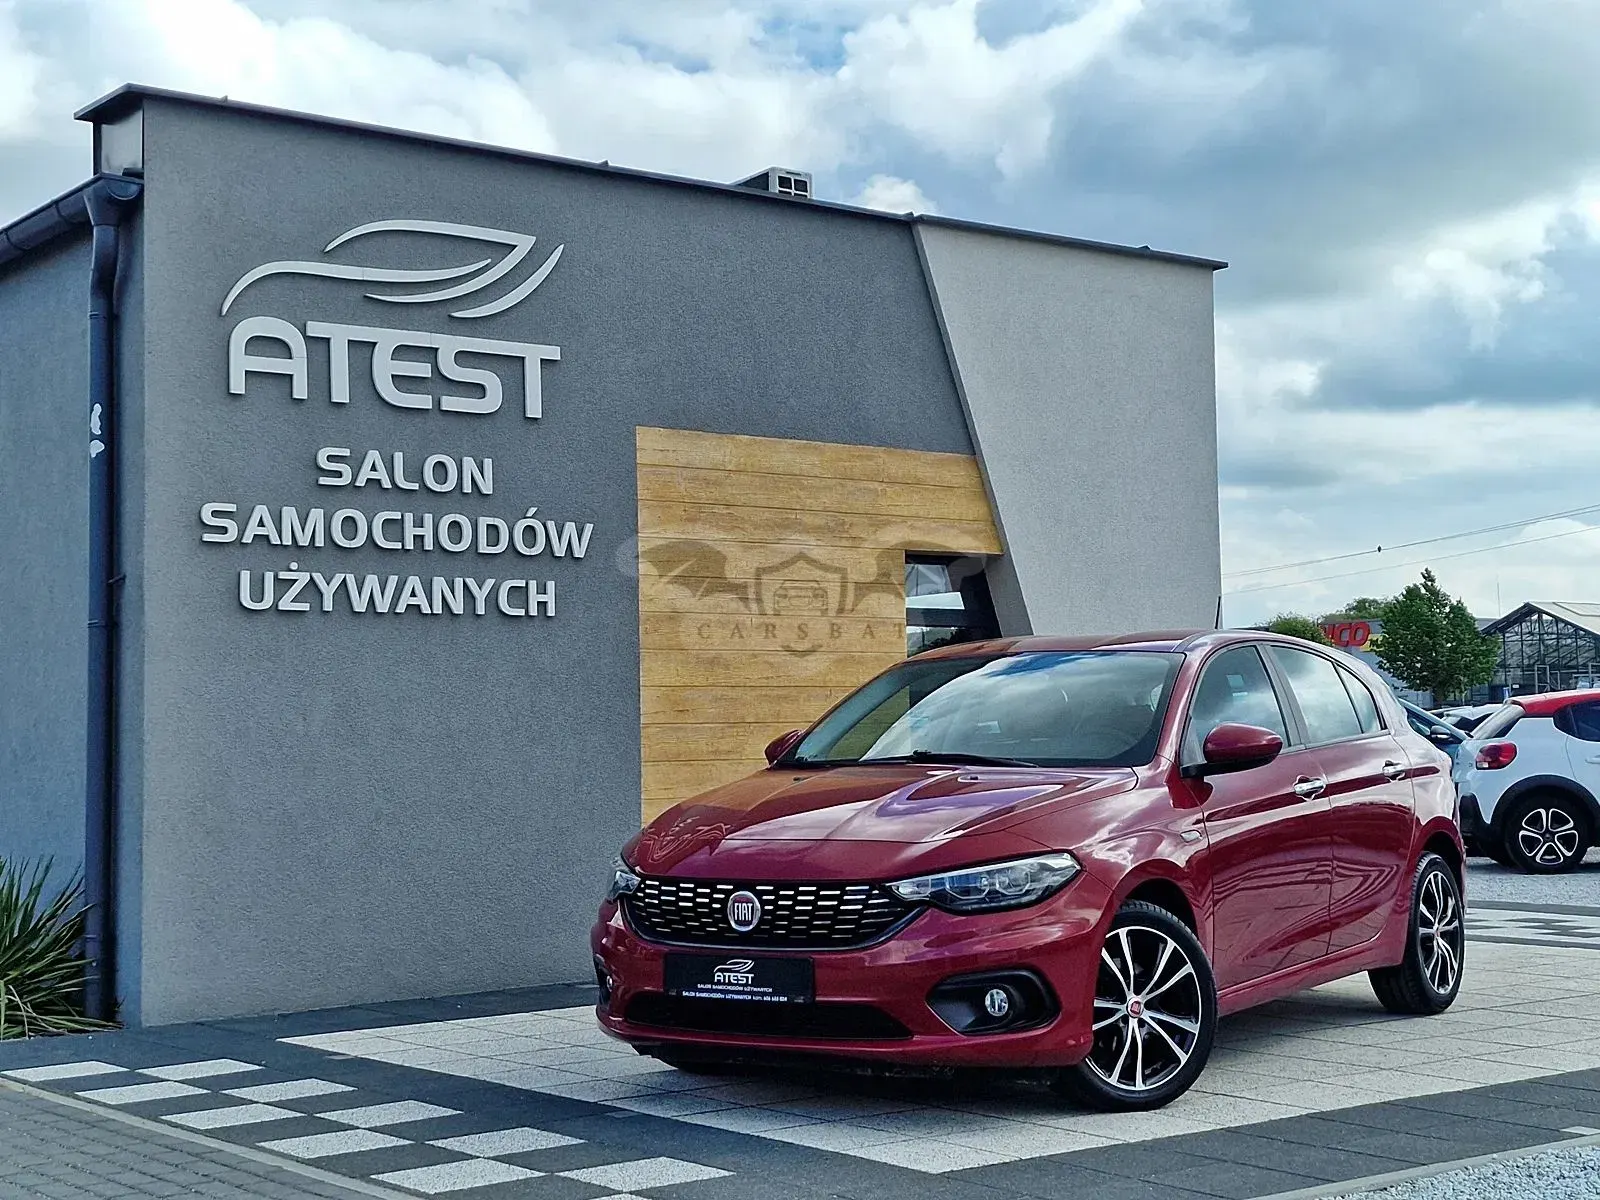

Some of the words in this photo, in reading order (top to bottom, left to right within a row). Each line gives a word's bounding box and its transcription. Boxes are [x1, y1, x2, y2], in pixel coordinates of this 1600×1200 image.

[228, 315, 561, 419] ATEST
[315, 446, 494, 495] SALON
[199, 501, 594, 559] SAMOCHODÓW
[238, 562, 557, 617] UŻYWANYCH
[734, 902, 753, 921] FIAT
[714, 972, 755, 984] ATEST
